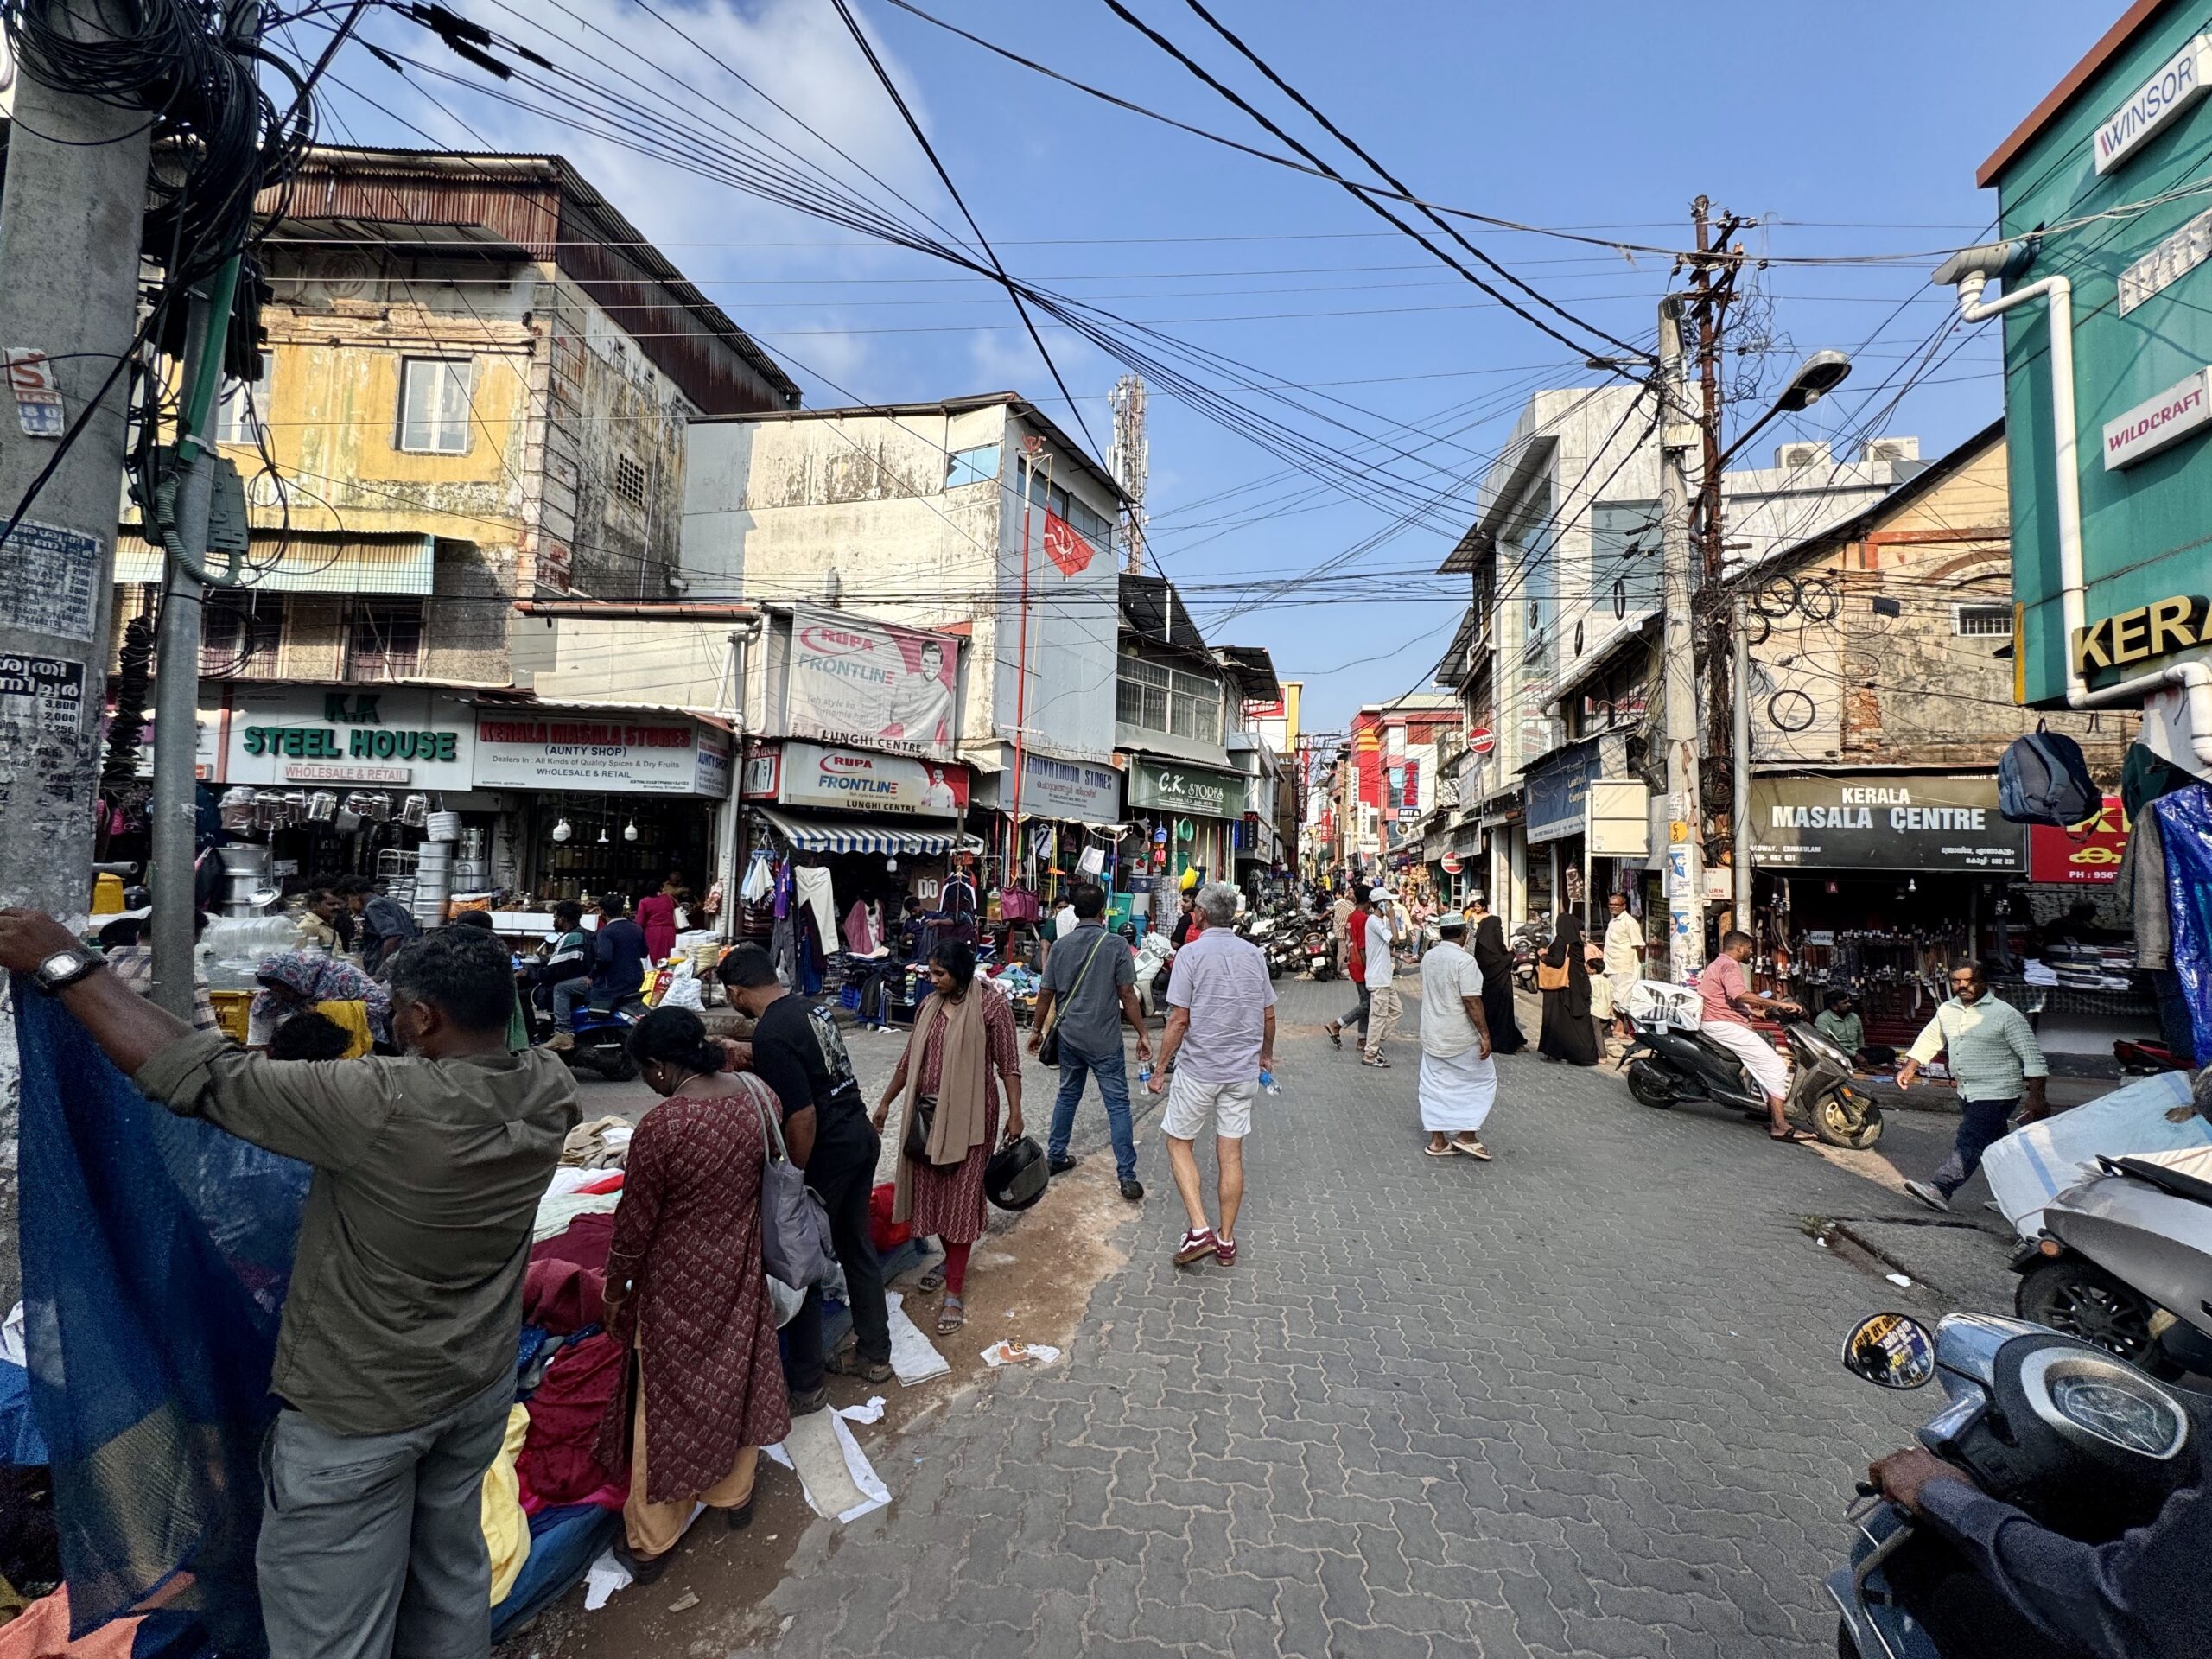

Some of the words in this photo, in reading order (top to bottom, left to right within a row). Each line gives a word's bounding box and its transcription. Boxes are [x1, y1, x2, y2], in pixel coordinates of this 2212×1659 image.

[2105, 56, 2192, 153] WINSOR
[2108, 389, 2203, 452] WILDCRAFT
[821, 628, 874, 651] RUPA
[798, 653, 896, 685] FRONTLINE
[823, 697, 843, 708] style
[244, 726, 342, 757] STEEL
[349, 728, 457, 760] HOUSE
[480, 721, 548, 744] KERALA
[550, 723, 623, 747] MASALA
[624, 726, 691, 748] STORES
[822, 729, 873, 747] LUNGHI
[878, 736, 923, 753] CENTRE
[492, 755, 520, 764] Dealers
[581, 759, 607, 768] Quality
[608, 760, 633, 768] Spices
[545, 745, 587, 756] (AUNTY
[591, 747, 627, 758] SHOP)
[698, 751, 715, 768] AUNTY
[715, 756, 728, 772] SHOP
[834, 756, 873, 768] RUPA
[285, 766, 353, 779] WHOLESALE
[356, 767, 365, 779] &
[368, 768, 405, 781] RETAIL
[601, 770, 632, 779] RETAIL
[1085, 769, 1112, 790] STORES
[818, 775, 899, 794] FRONTLINE
[1159, 772, 1185, 795] C.K.
[1188, 783, 1224, 800] STORES
[846, 799, 880, 810] LUNGHI
[883, 803, 916, 812] CENTRE
[1841, 787, 1911, 804] KERALA
[1771, 805, 1873, 829] MASALA
[1890, 807, 1986, 830] CENTRE
